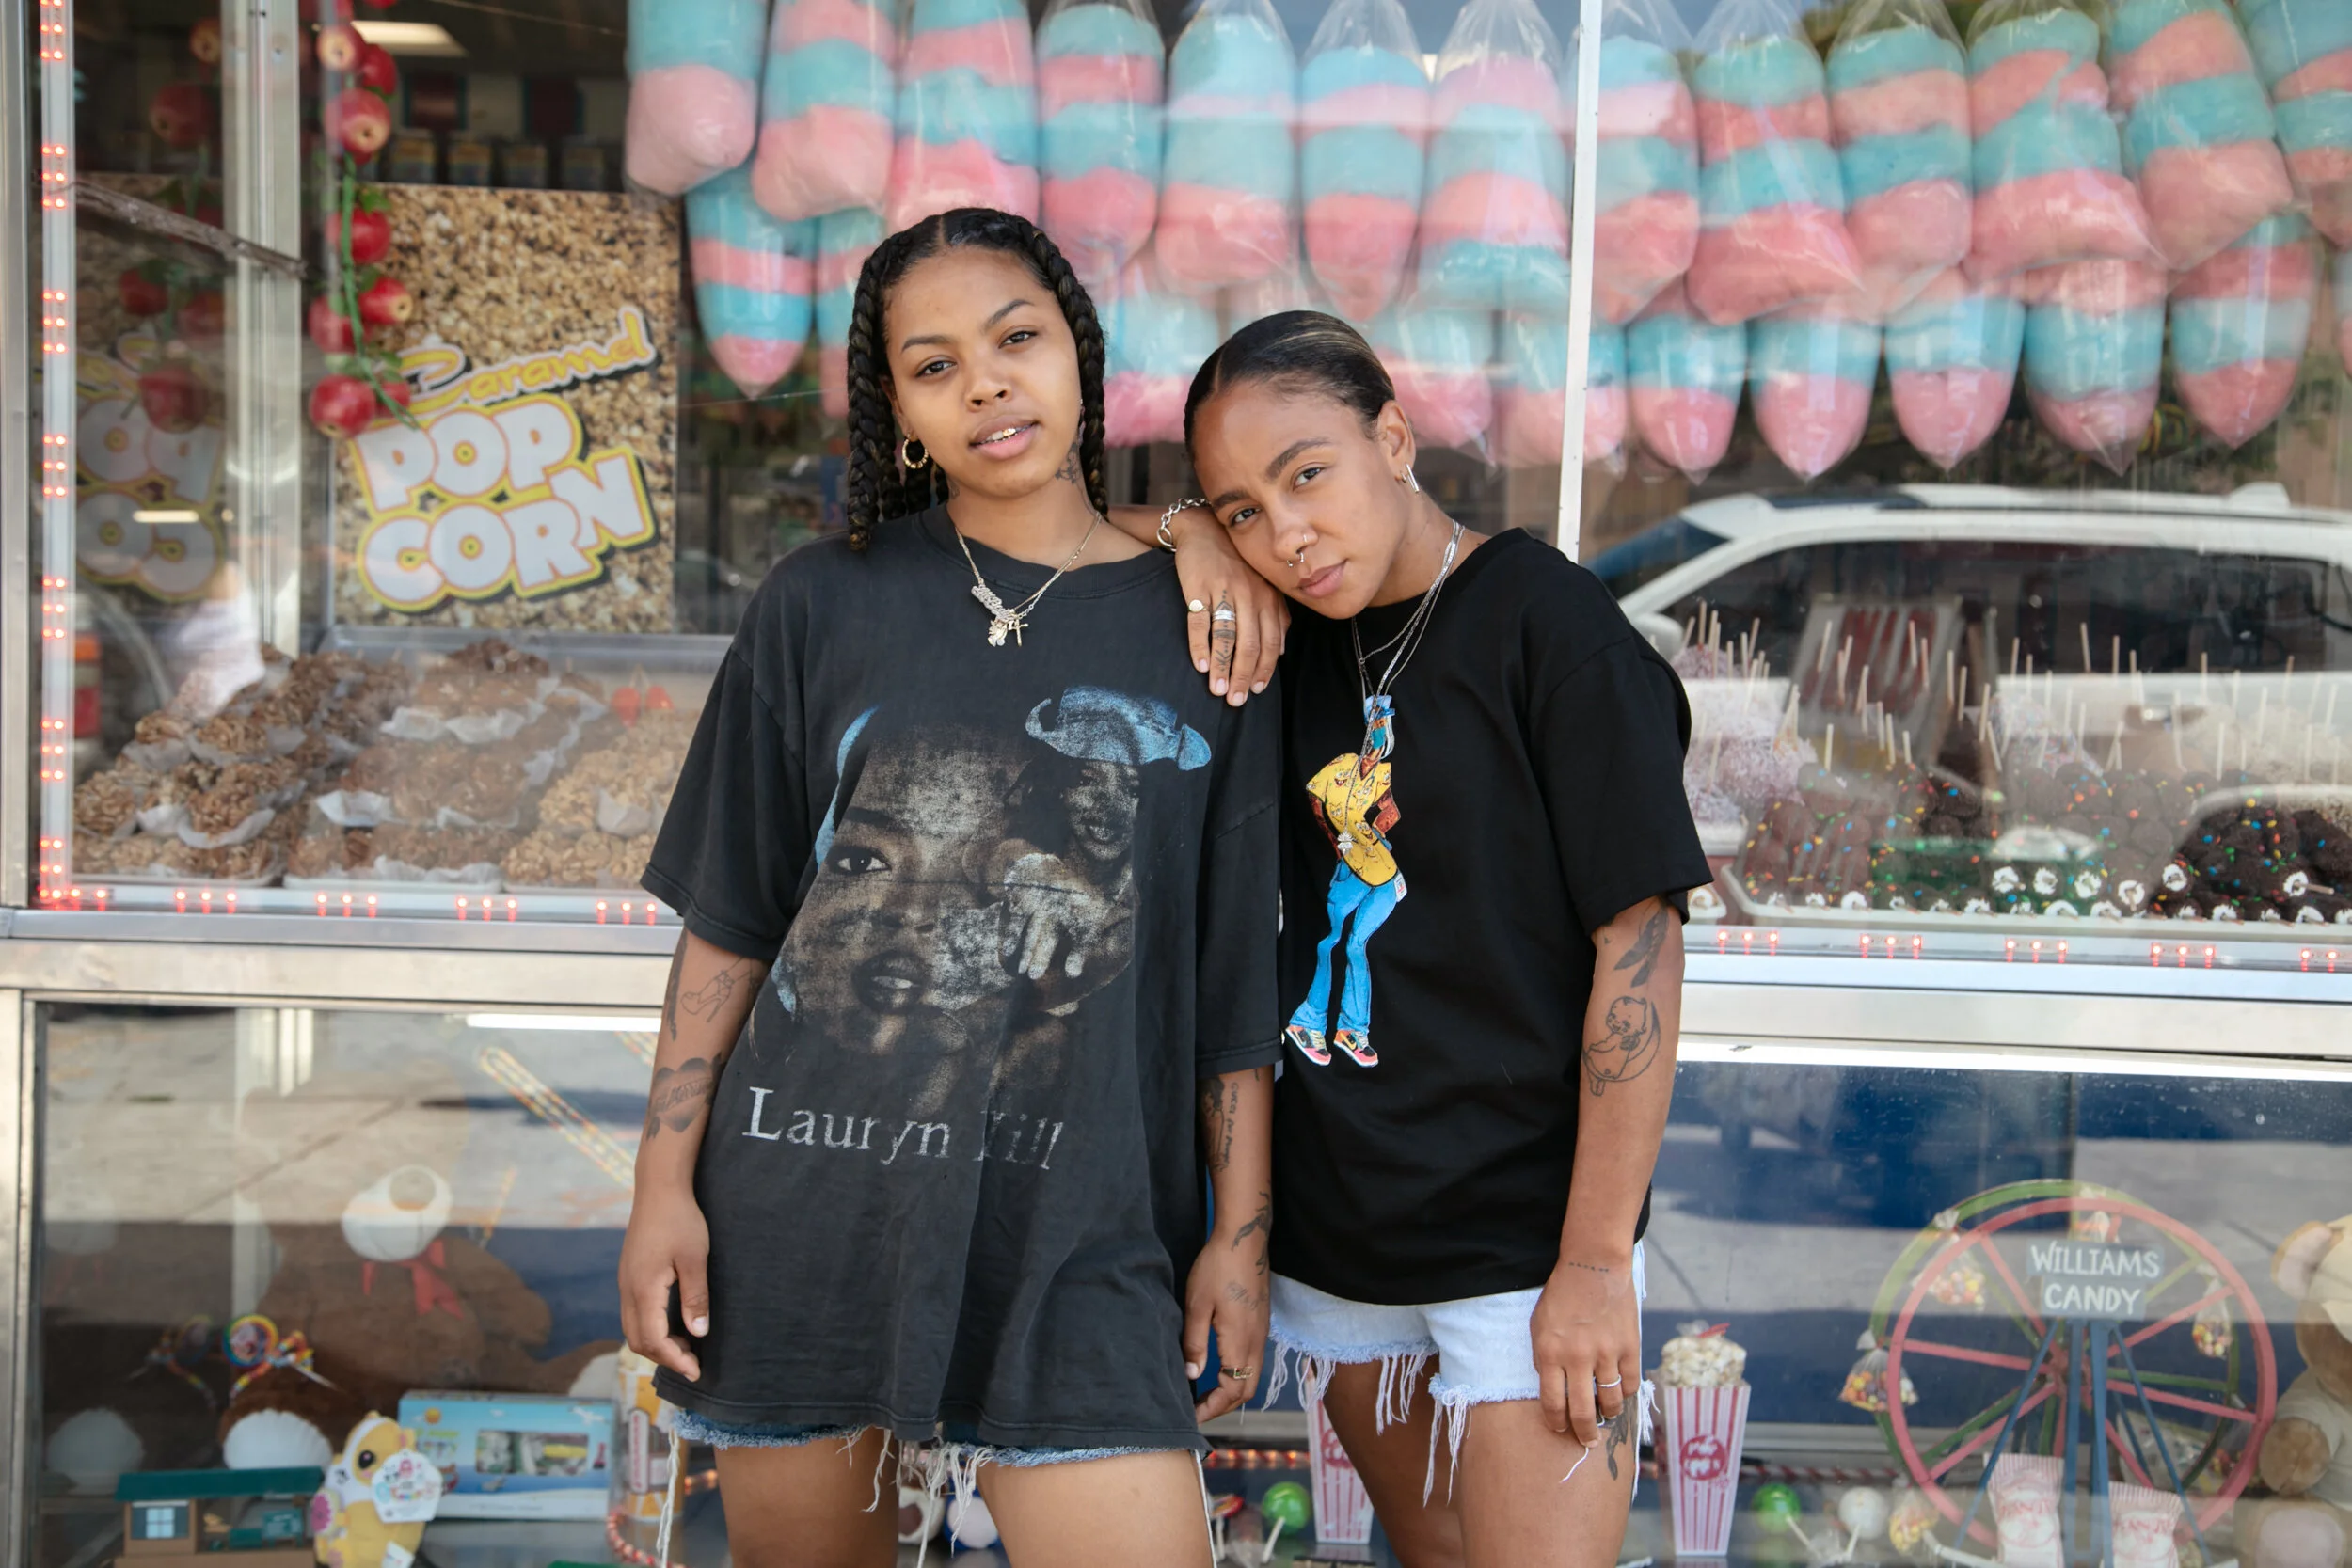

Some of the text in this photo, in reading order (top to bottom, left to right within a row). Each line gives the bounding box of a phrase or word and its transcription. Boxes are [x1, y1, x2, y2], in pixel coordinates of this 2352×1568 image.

[355, 401, 574, 514] POP
[363, 454, 647, 603] CORN
[741, 1085, 952, 1166] Lauryn
[2030, 1239, 2161, 1279] WILLIAMS
[2043, 1282, 2141, 1316] CANDY
